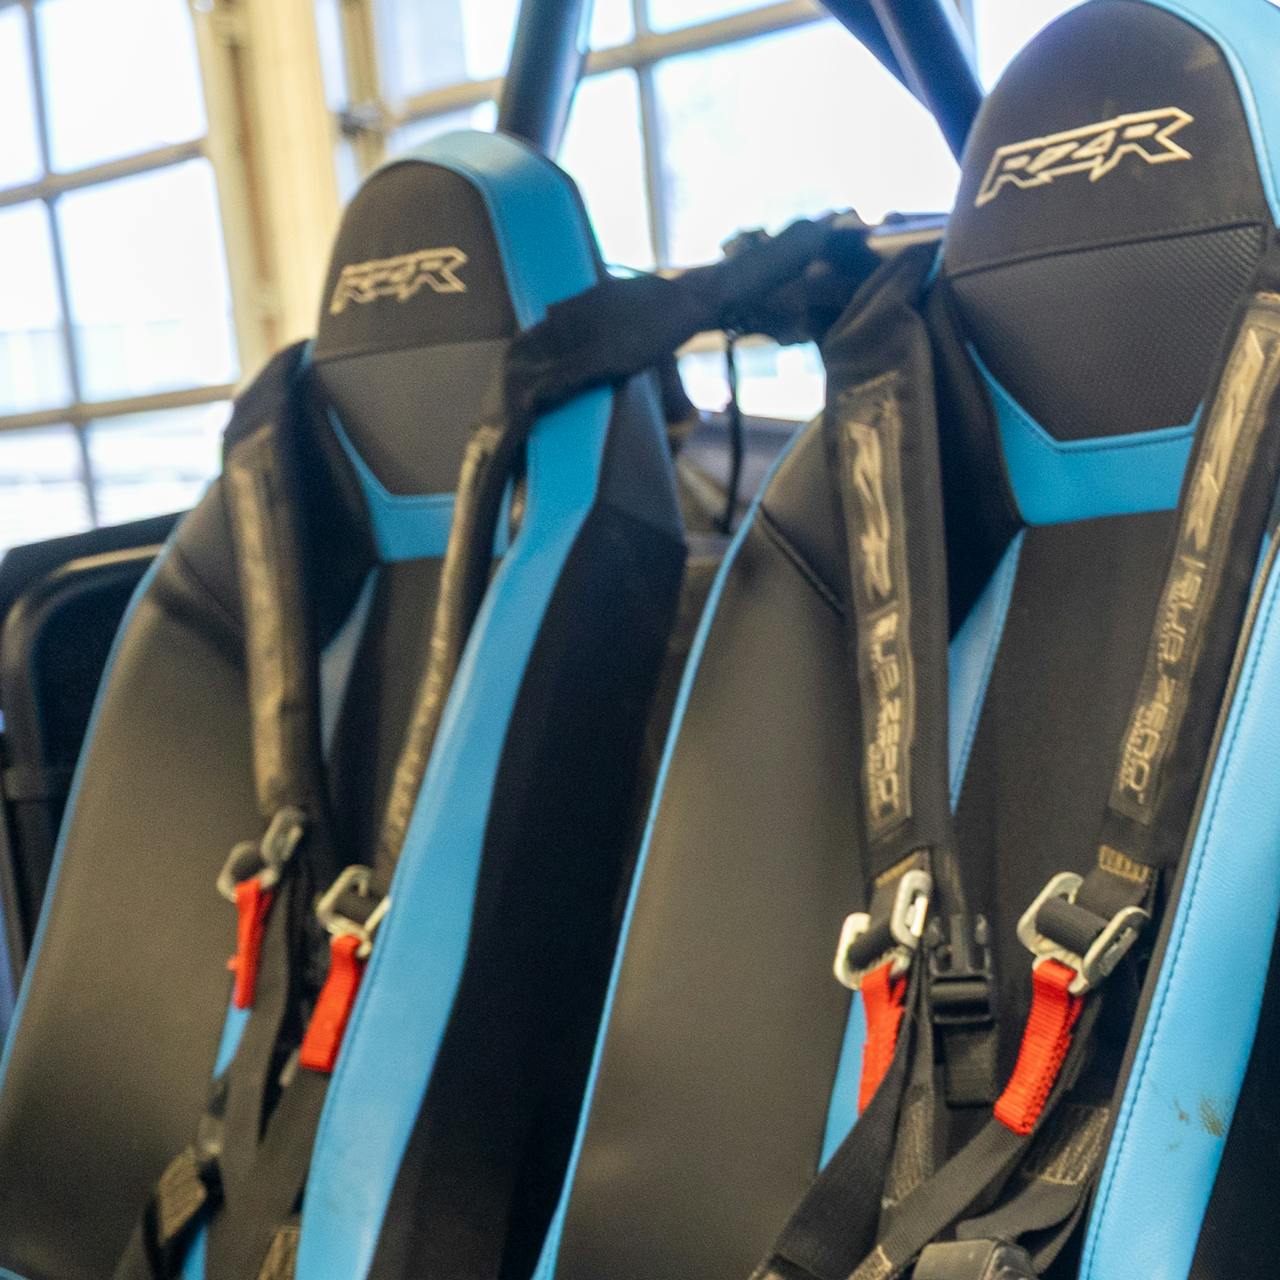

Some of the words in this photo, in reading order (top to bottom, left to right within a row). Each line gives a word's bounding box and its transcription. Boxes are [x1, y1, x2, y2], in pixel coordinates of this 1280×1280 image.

[976, 107, 1194, 208] RZR
[329, 246, 468, 315] RZR
[1184, 329, 1264, 551] RZR
